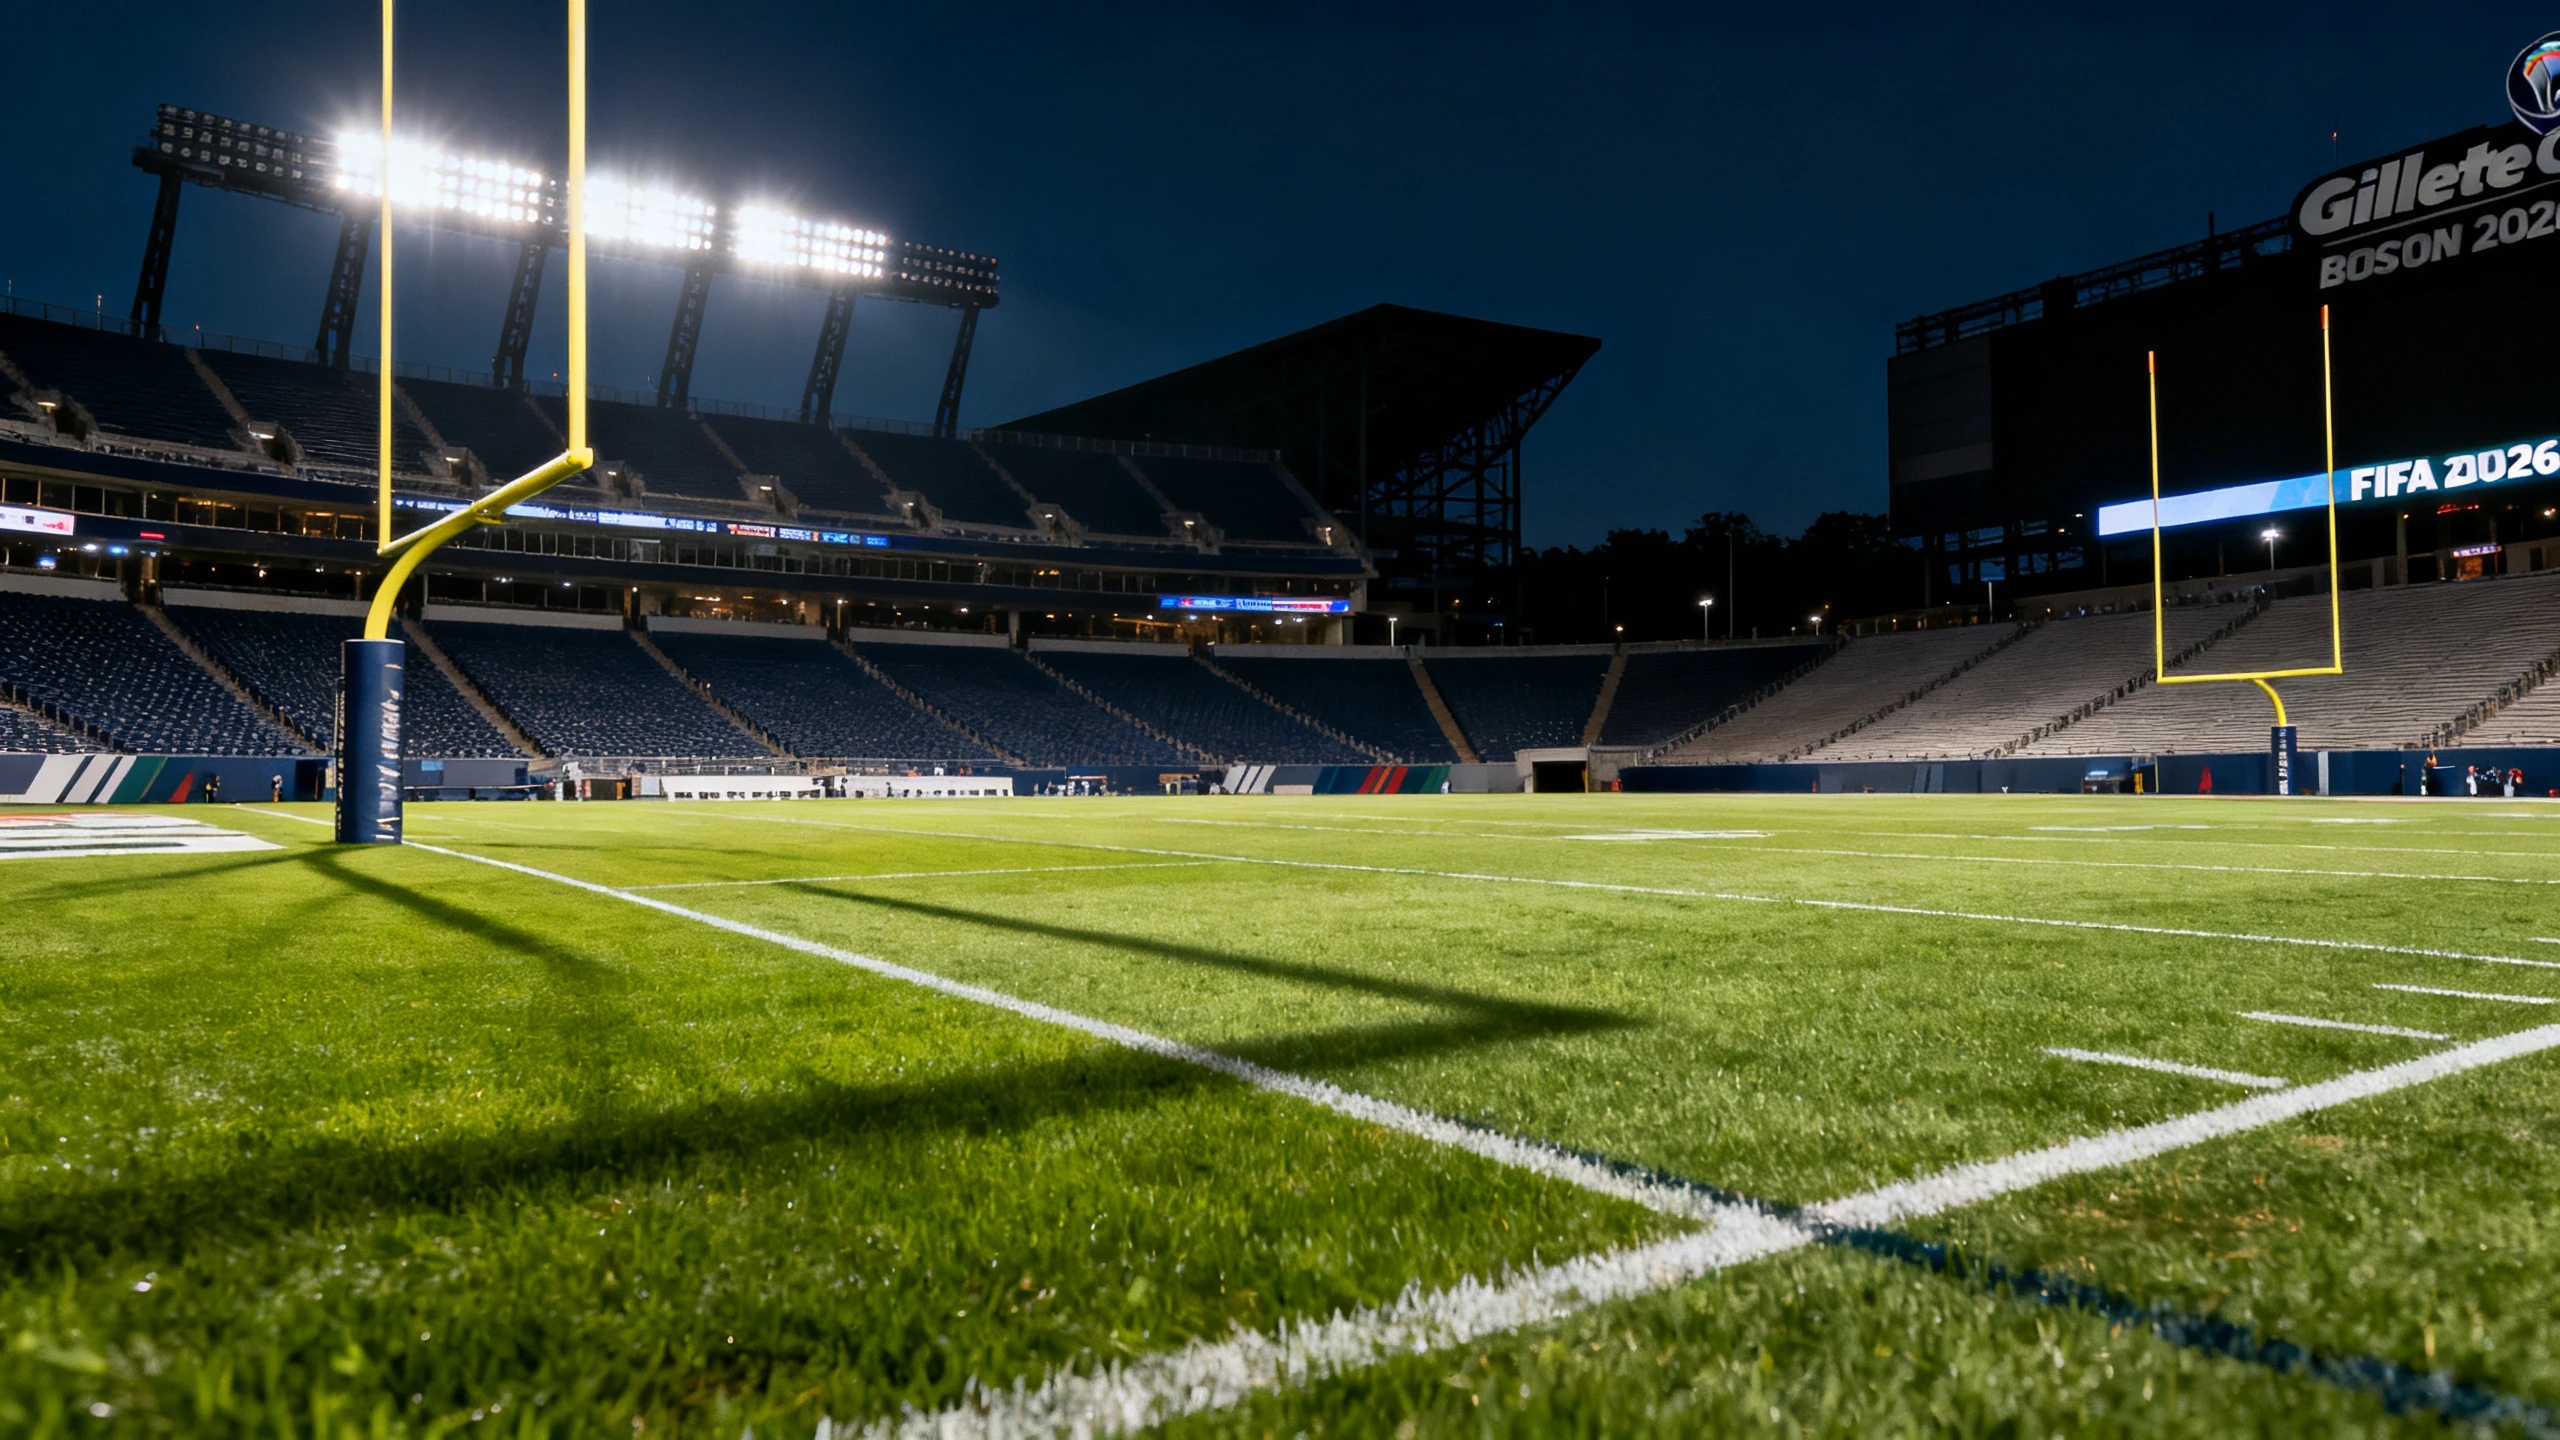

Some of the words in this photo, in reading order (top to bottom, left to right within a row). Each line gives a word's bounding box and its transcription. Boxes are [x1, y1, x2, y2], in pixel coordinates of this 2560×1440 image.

[2319, 223, 2463, 289] BOSON
[2472, 200, 2560, 252] 202
[2351, 459, 2438, 501] FIFA
